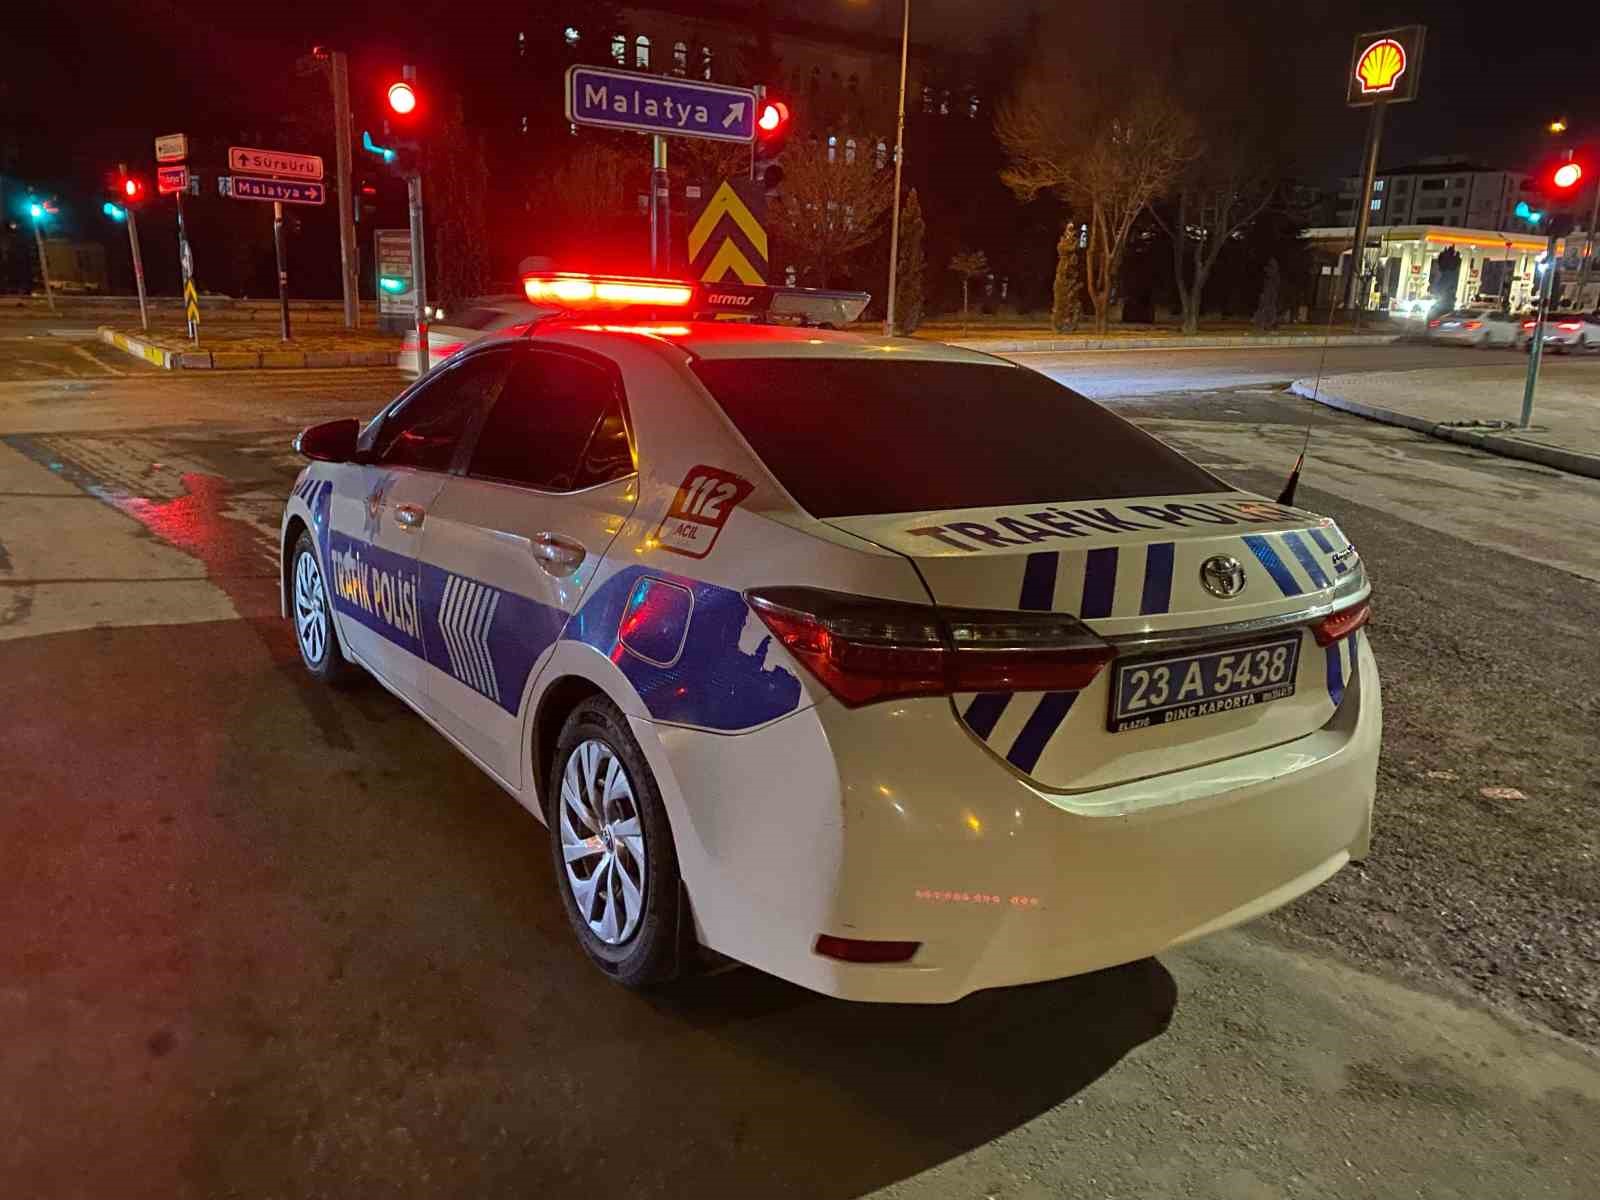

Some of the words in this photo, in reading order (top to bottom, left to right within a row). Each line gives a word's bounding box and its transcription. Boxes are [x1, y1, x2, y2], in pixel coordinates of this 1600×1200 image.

[585, 84, 708, 126] Malatya
[239, 182, 300, 199] Malatya
[681, 476, 737, 520] 112
[905, 507, 1163, 552] TRAFİK
[372, 567, 420, 640] POLİSİ
[1128, 667, 1170, 710] 23
[1177, 661, 1205, 700] A
[1214, 647, 1288, 693] 5438
[1198, 693, 1255, 716] KAPORTA
